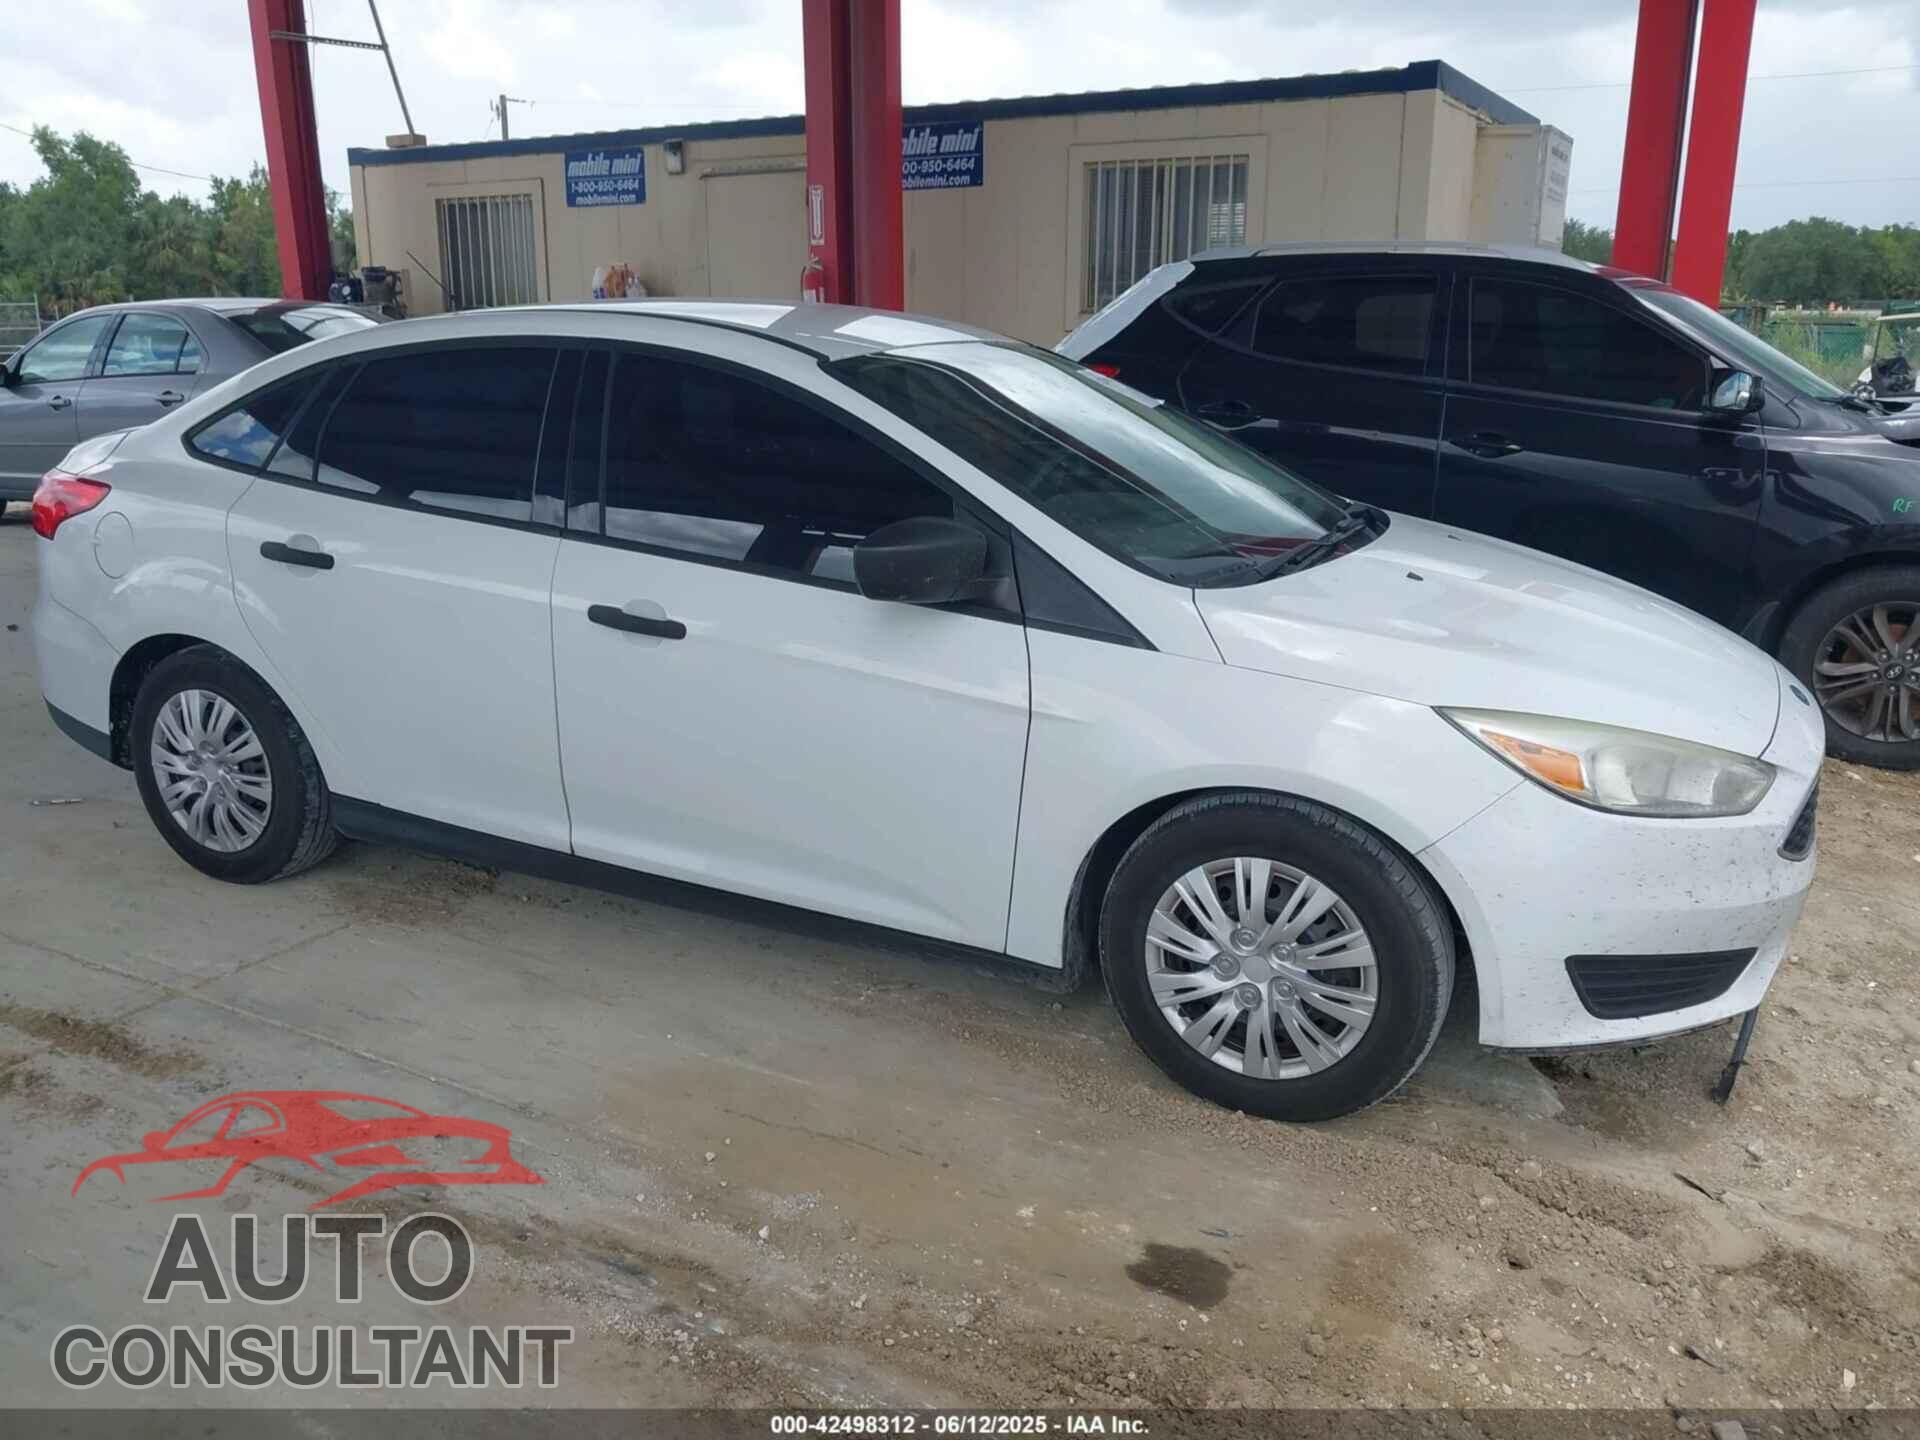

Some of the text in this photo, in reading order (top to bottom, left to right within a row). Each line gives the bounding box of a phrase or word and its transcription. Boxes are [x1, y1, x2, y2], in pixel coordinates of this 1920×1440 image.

[940, 127, 979, 153] mini
[568, 152, 642, 177] mobile mini
